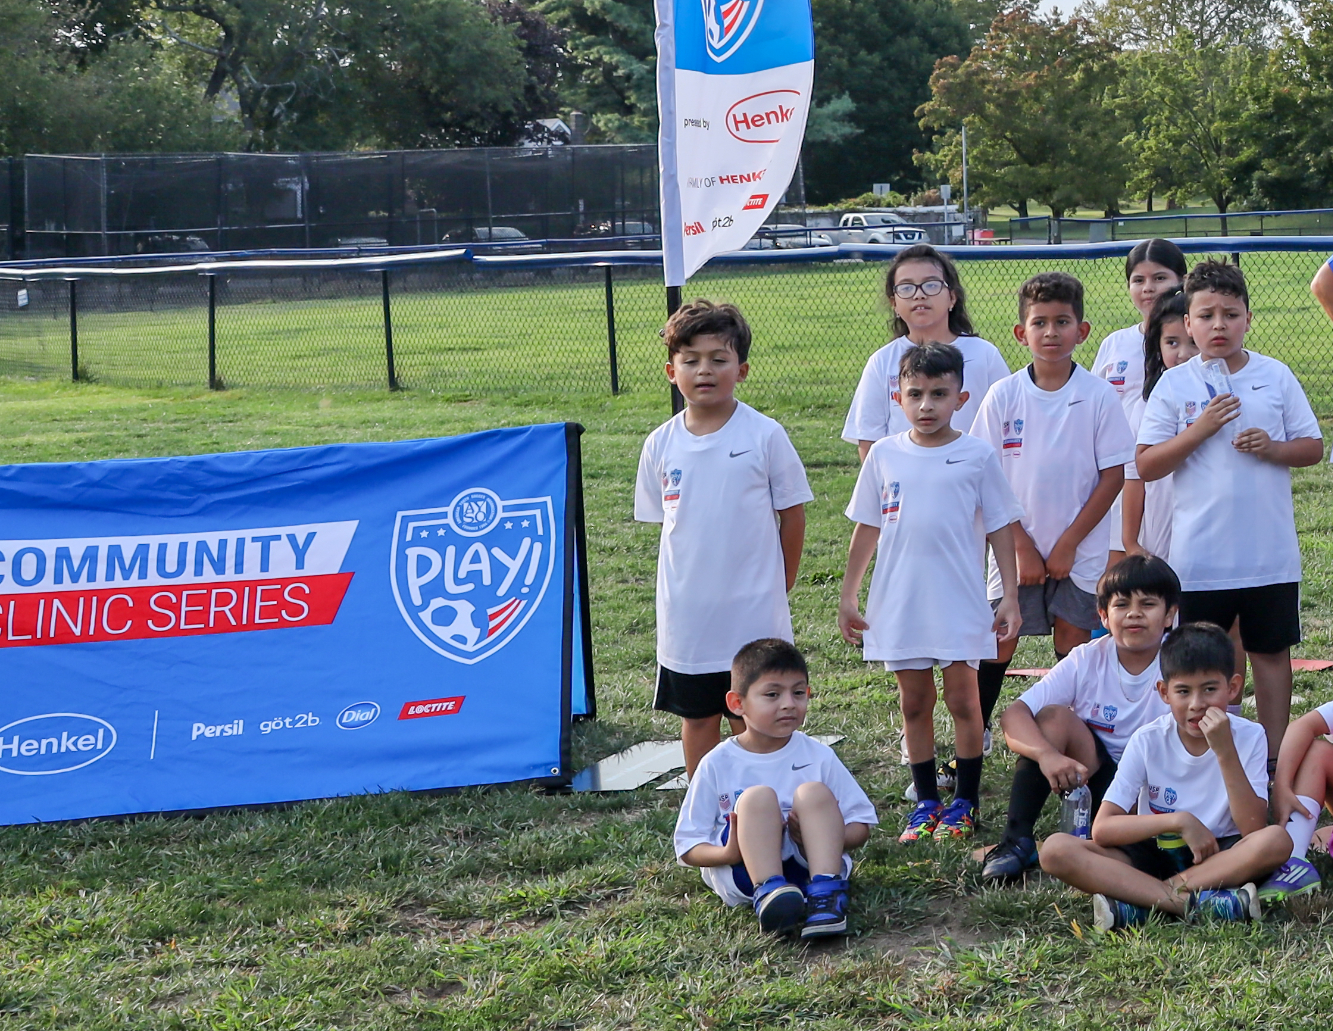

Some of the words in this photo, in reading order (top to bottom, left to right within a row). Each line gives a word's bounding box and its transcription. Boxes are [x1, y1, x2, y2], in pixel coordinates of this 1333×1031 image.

[732, 104, 795, 131] Henk
[704, 176, 716, 188] OF
[718, 169, 766, 184] HENK
[0, 531, 317, 587] OMMUNITY
[404, 536, 543, 606] PLAY!
[0, 593, 134, 641] LINIC
[147, 582, 310, 632] SERIES
[191, 719, 244, 741] Persil
[259, 713, 321, 734] göt2b
[341, 707, 376, 723] Dial
[407, 701, 456, 715] LOCTITE
[0, 727, 105, 759] Henkel
